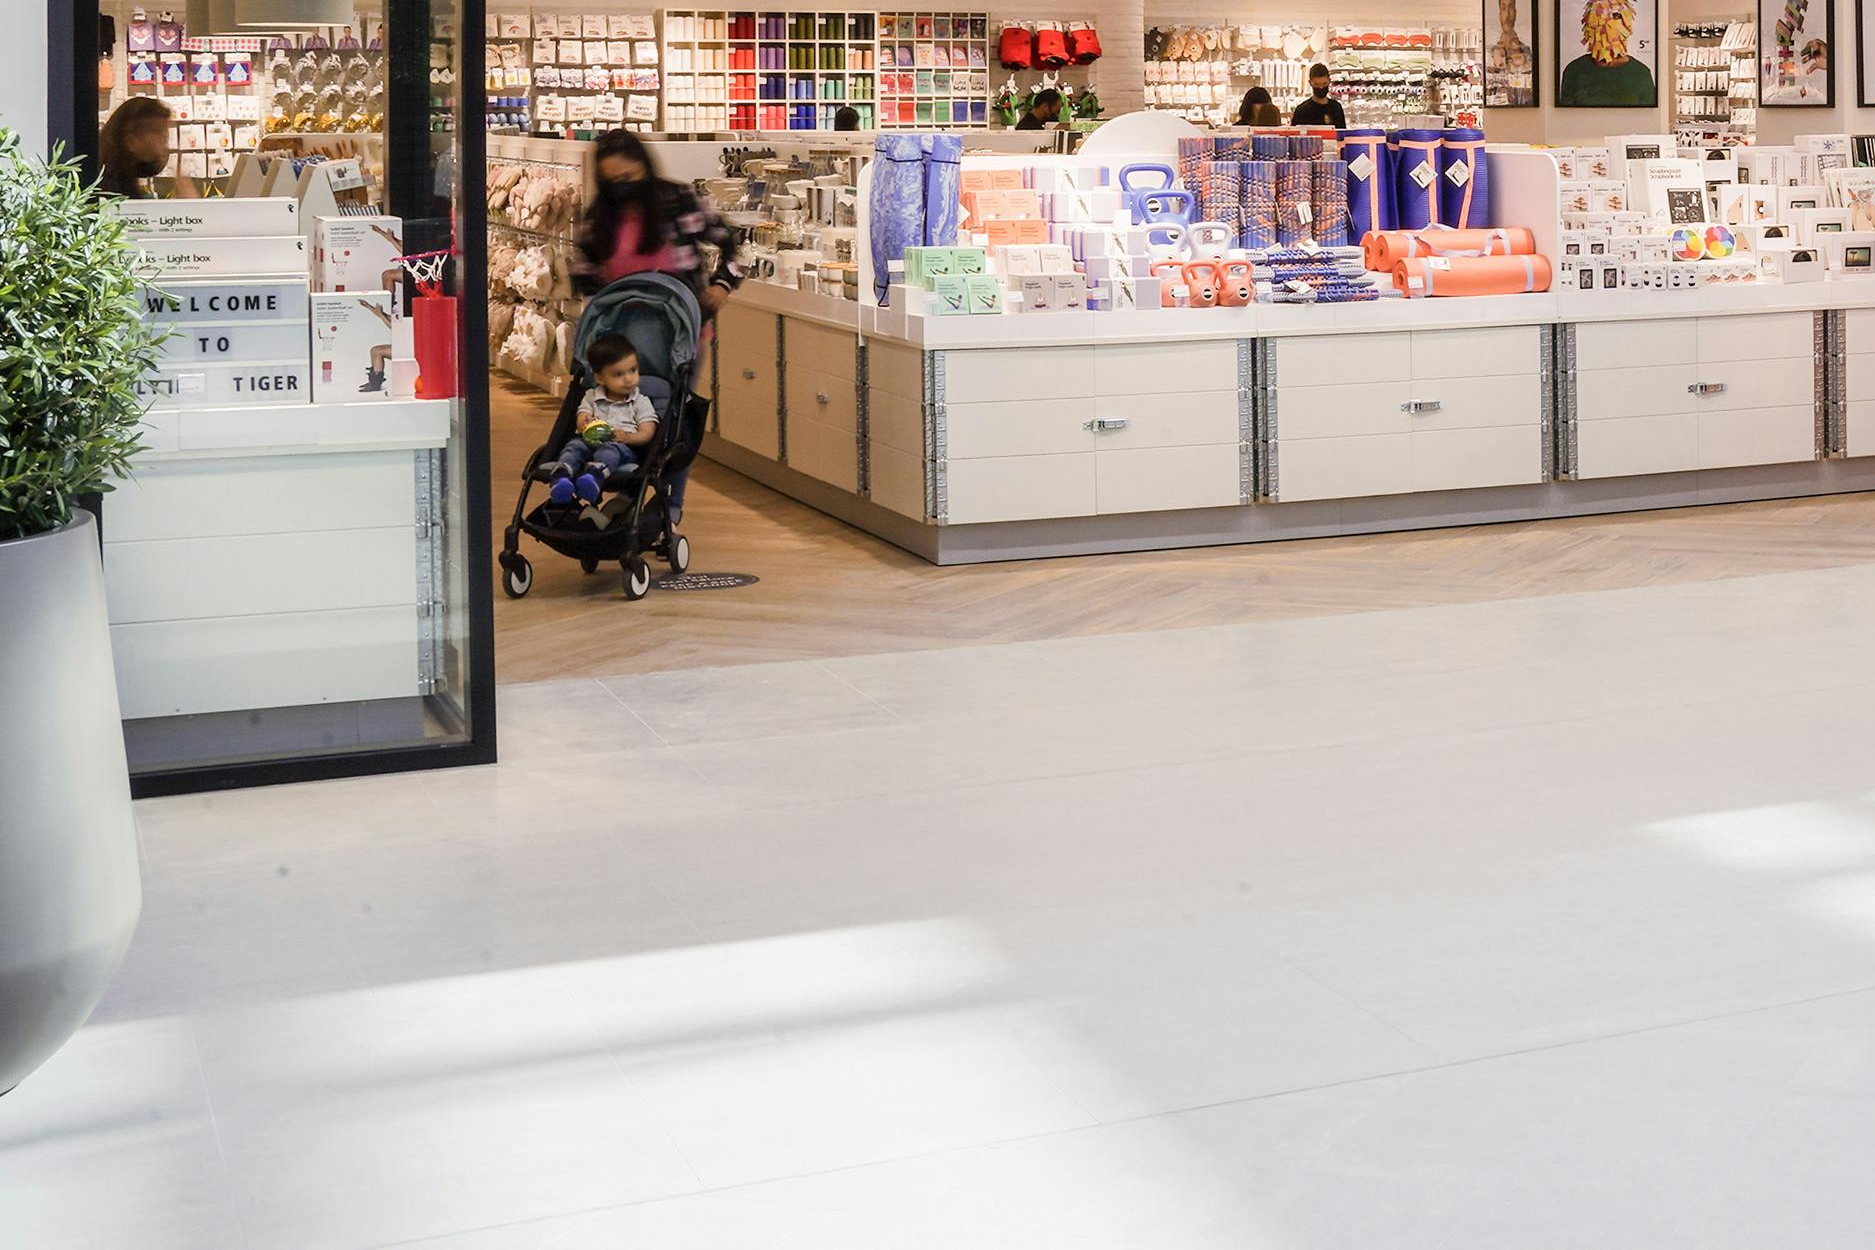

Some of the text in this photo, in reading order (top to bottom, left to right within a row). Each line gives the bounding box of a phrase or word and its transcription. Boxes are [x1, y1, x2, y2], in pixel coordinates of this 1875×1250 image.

[159, 215, 183, 227] Light
[185, 216, 204, 225] box
[167, 253, 191, 265] Light
[193, 254, 212, 263] box
[198, 336, 230, 353] TO
[233, 375, 299, 392] TIGER
